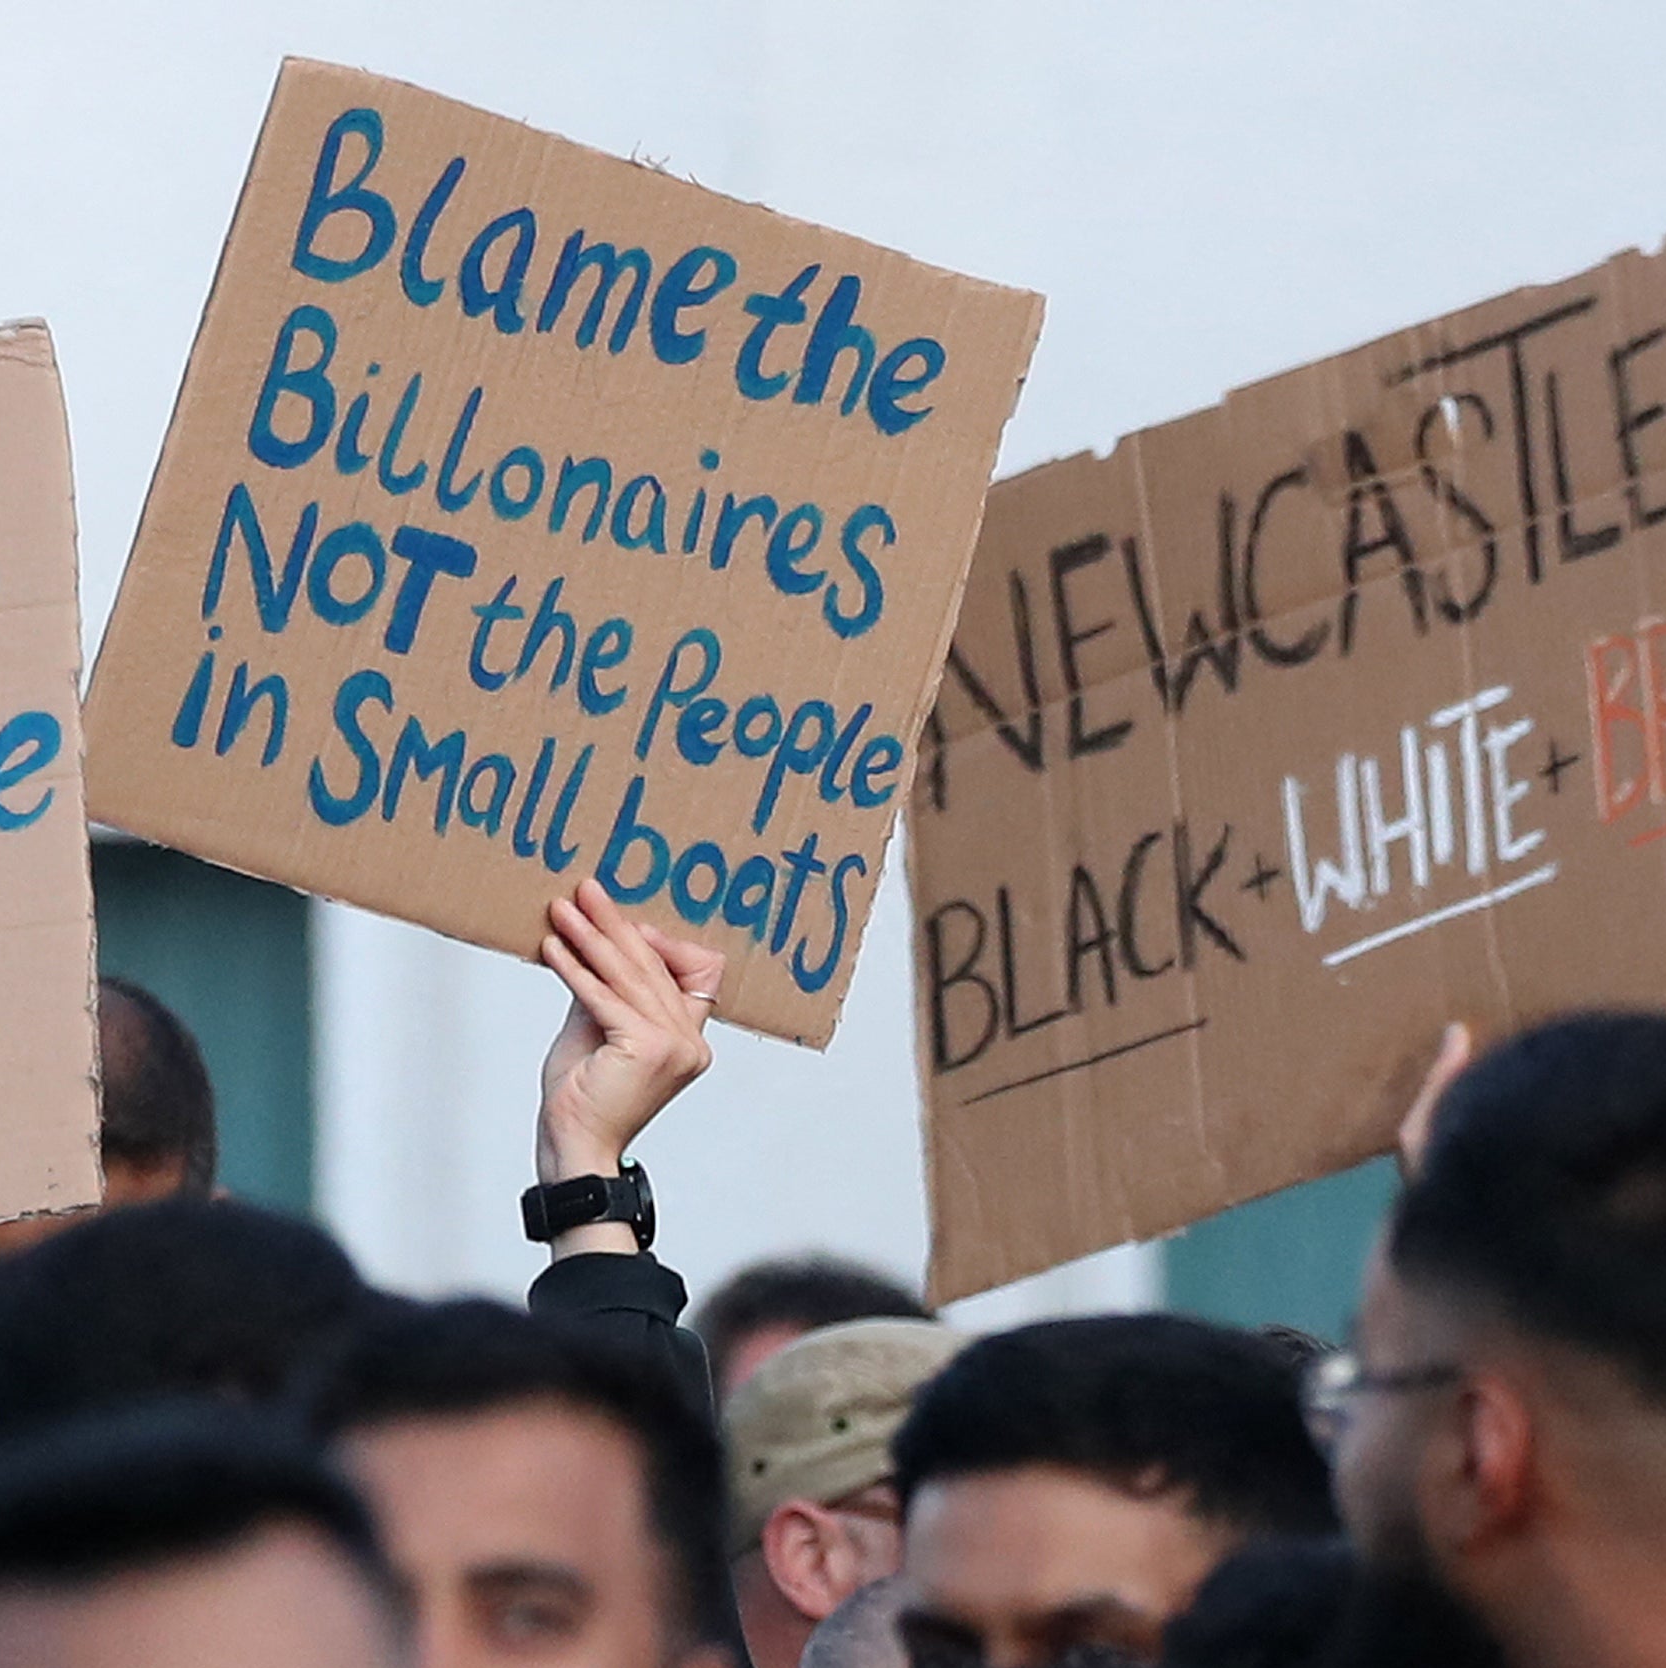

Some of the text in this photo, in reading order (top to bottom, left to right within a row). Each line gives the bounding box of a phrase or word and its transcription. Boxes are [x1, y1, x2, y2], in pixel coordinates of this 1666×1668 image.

[291, 107, 947, 436] Blame the
[248, 304, 898, 640] Billonaires
[171, 627, 289, 769] in
[595, 776, 867, 995] boats
[201, 483, 907, 836] NOT the People
[923, 822, 1248, 1075] BLACK
[1283, 684, 1547, 935] WHITE
